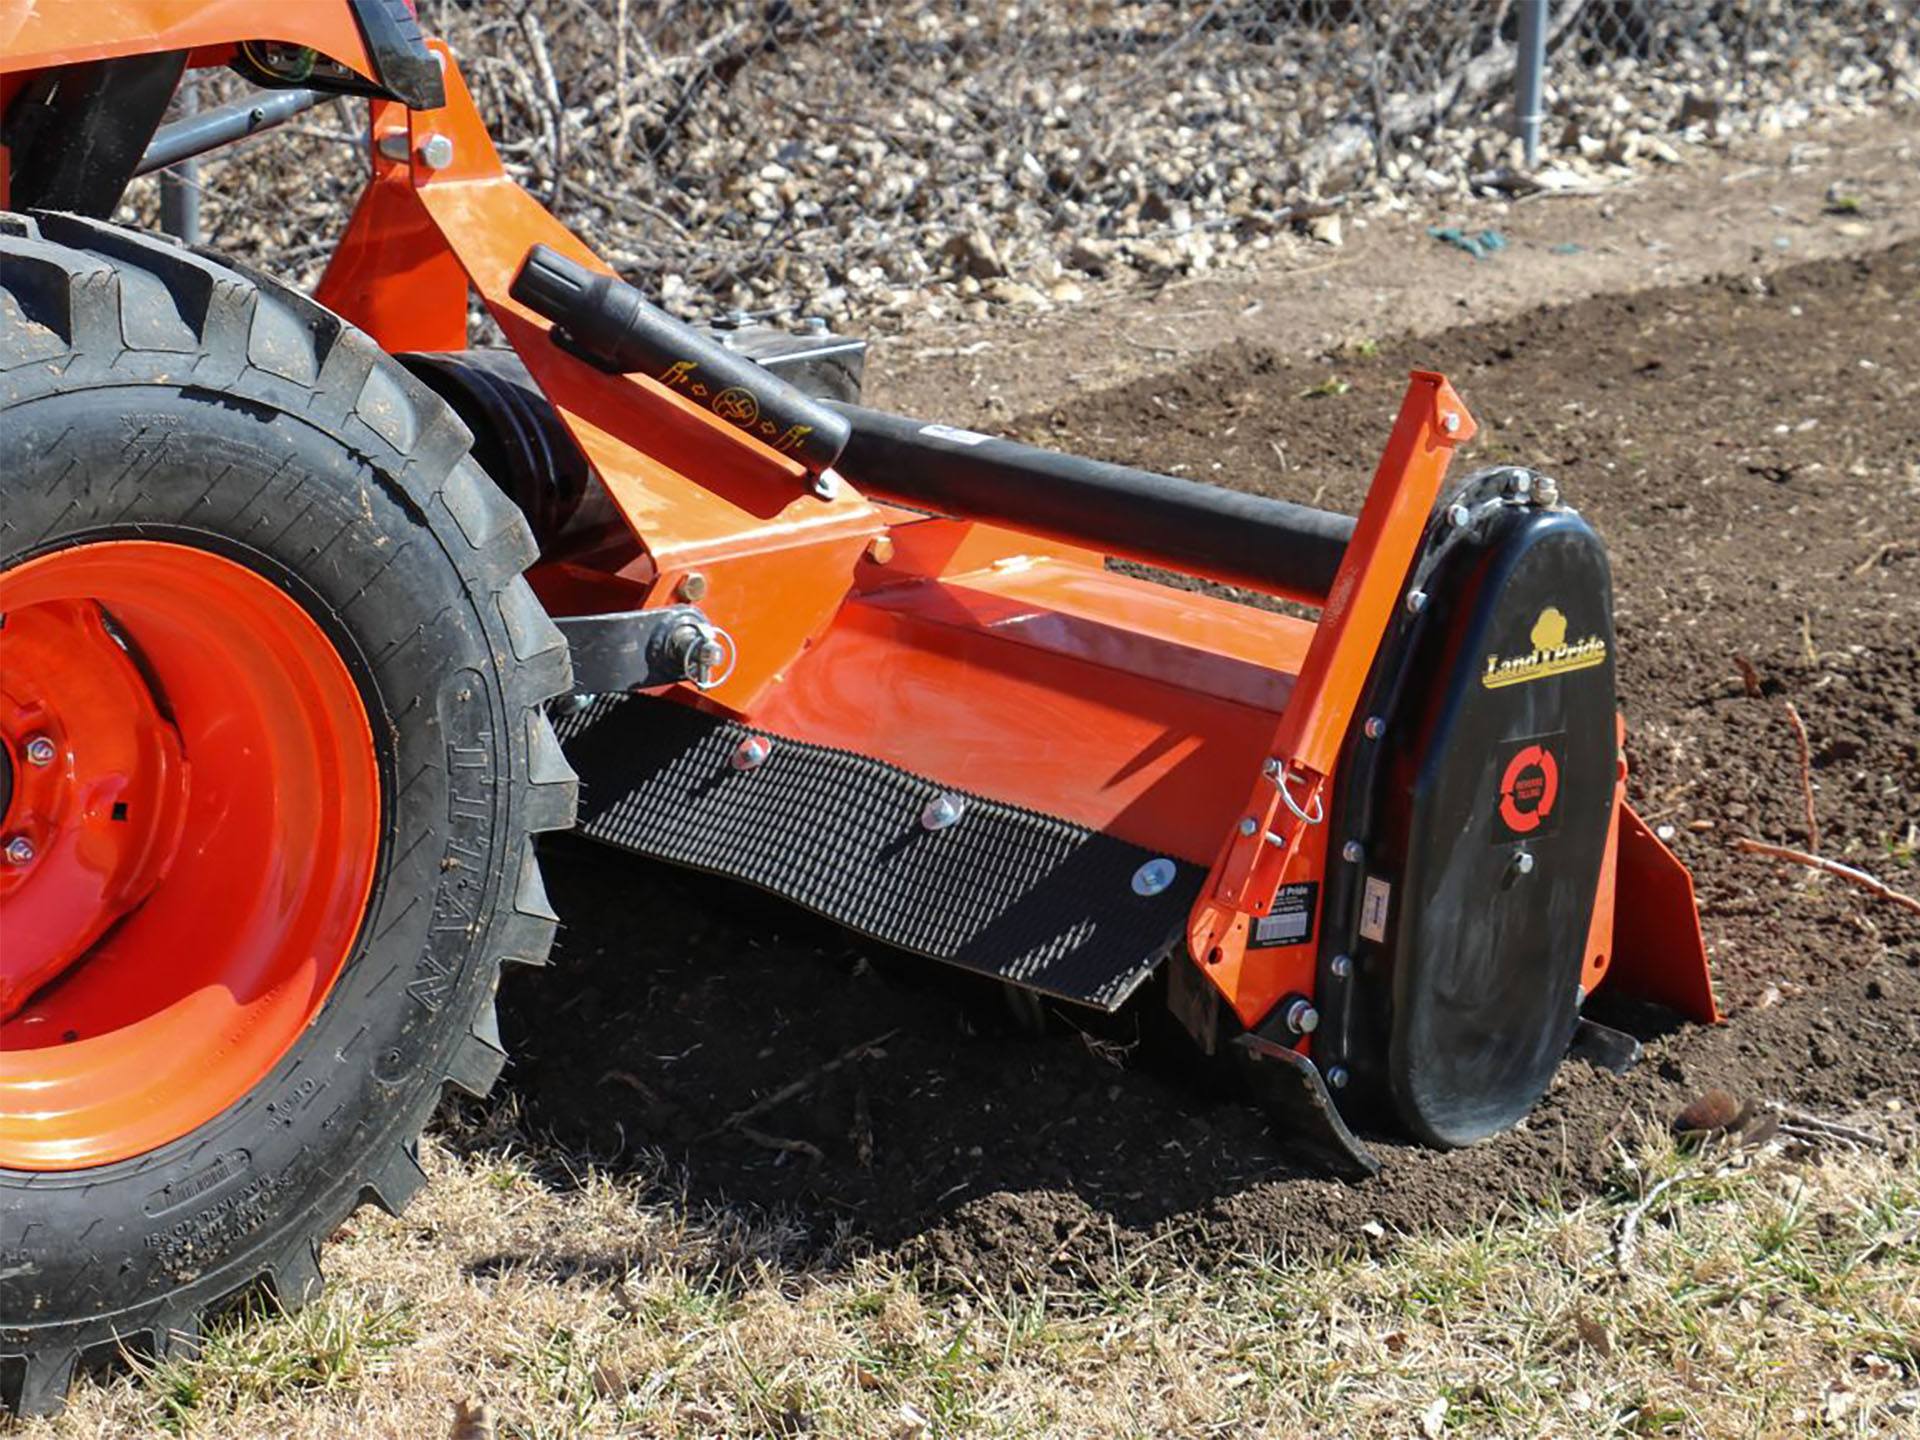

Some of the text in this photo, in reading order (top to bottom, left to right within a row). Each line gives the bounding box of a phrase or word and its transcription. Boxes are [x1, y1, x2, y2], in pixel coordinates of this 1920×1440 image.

[1485, 635, 1606, 677] Land Pride
[405, 731, 491, 1013] TITAN
